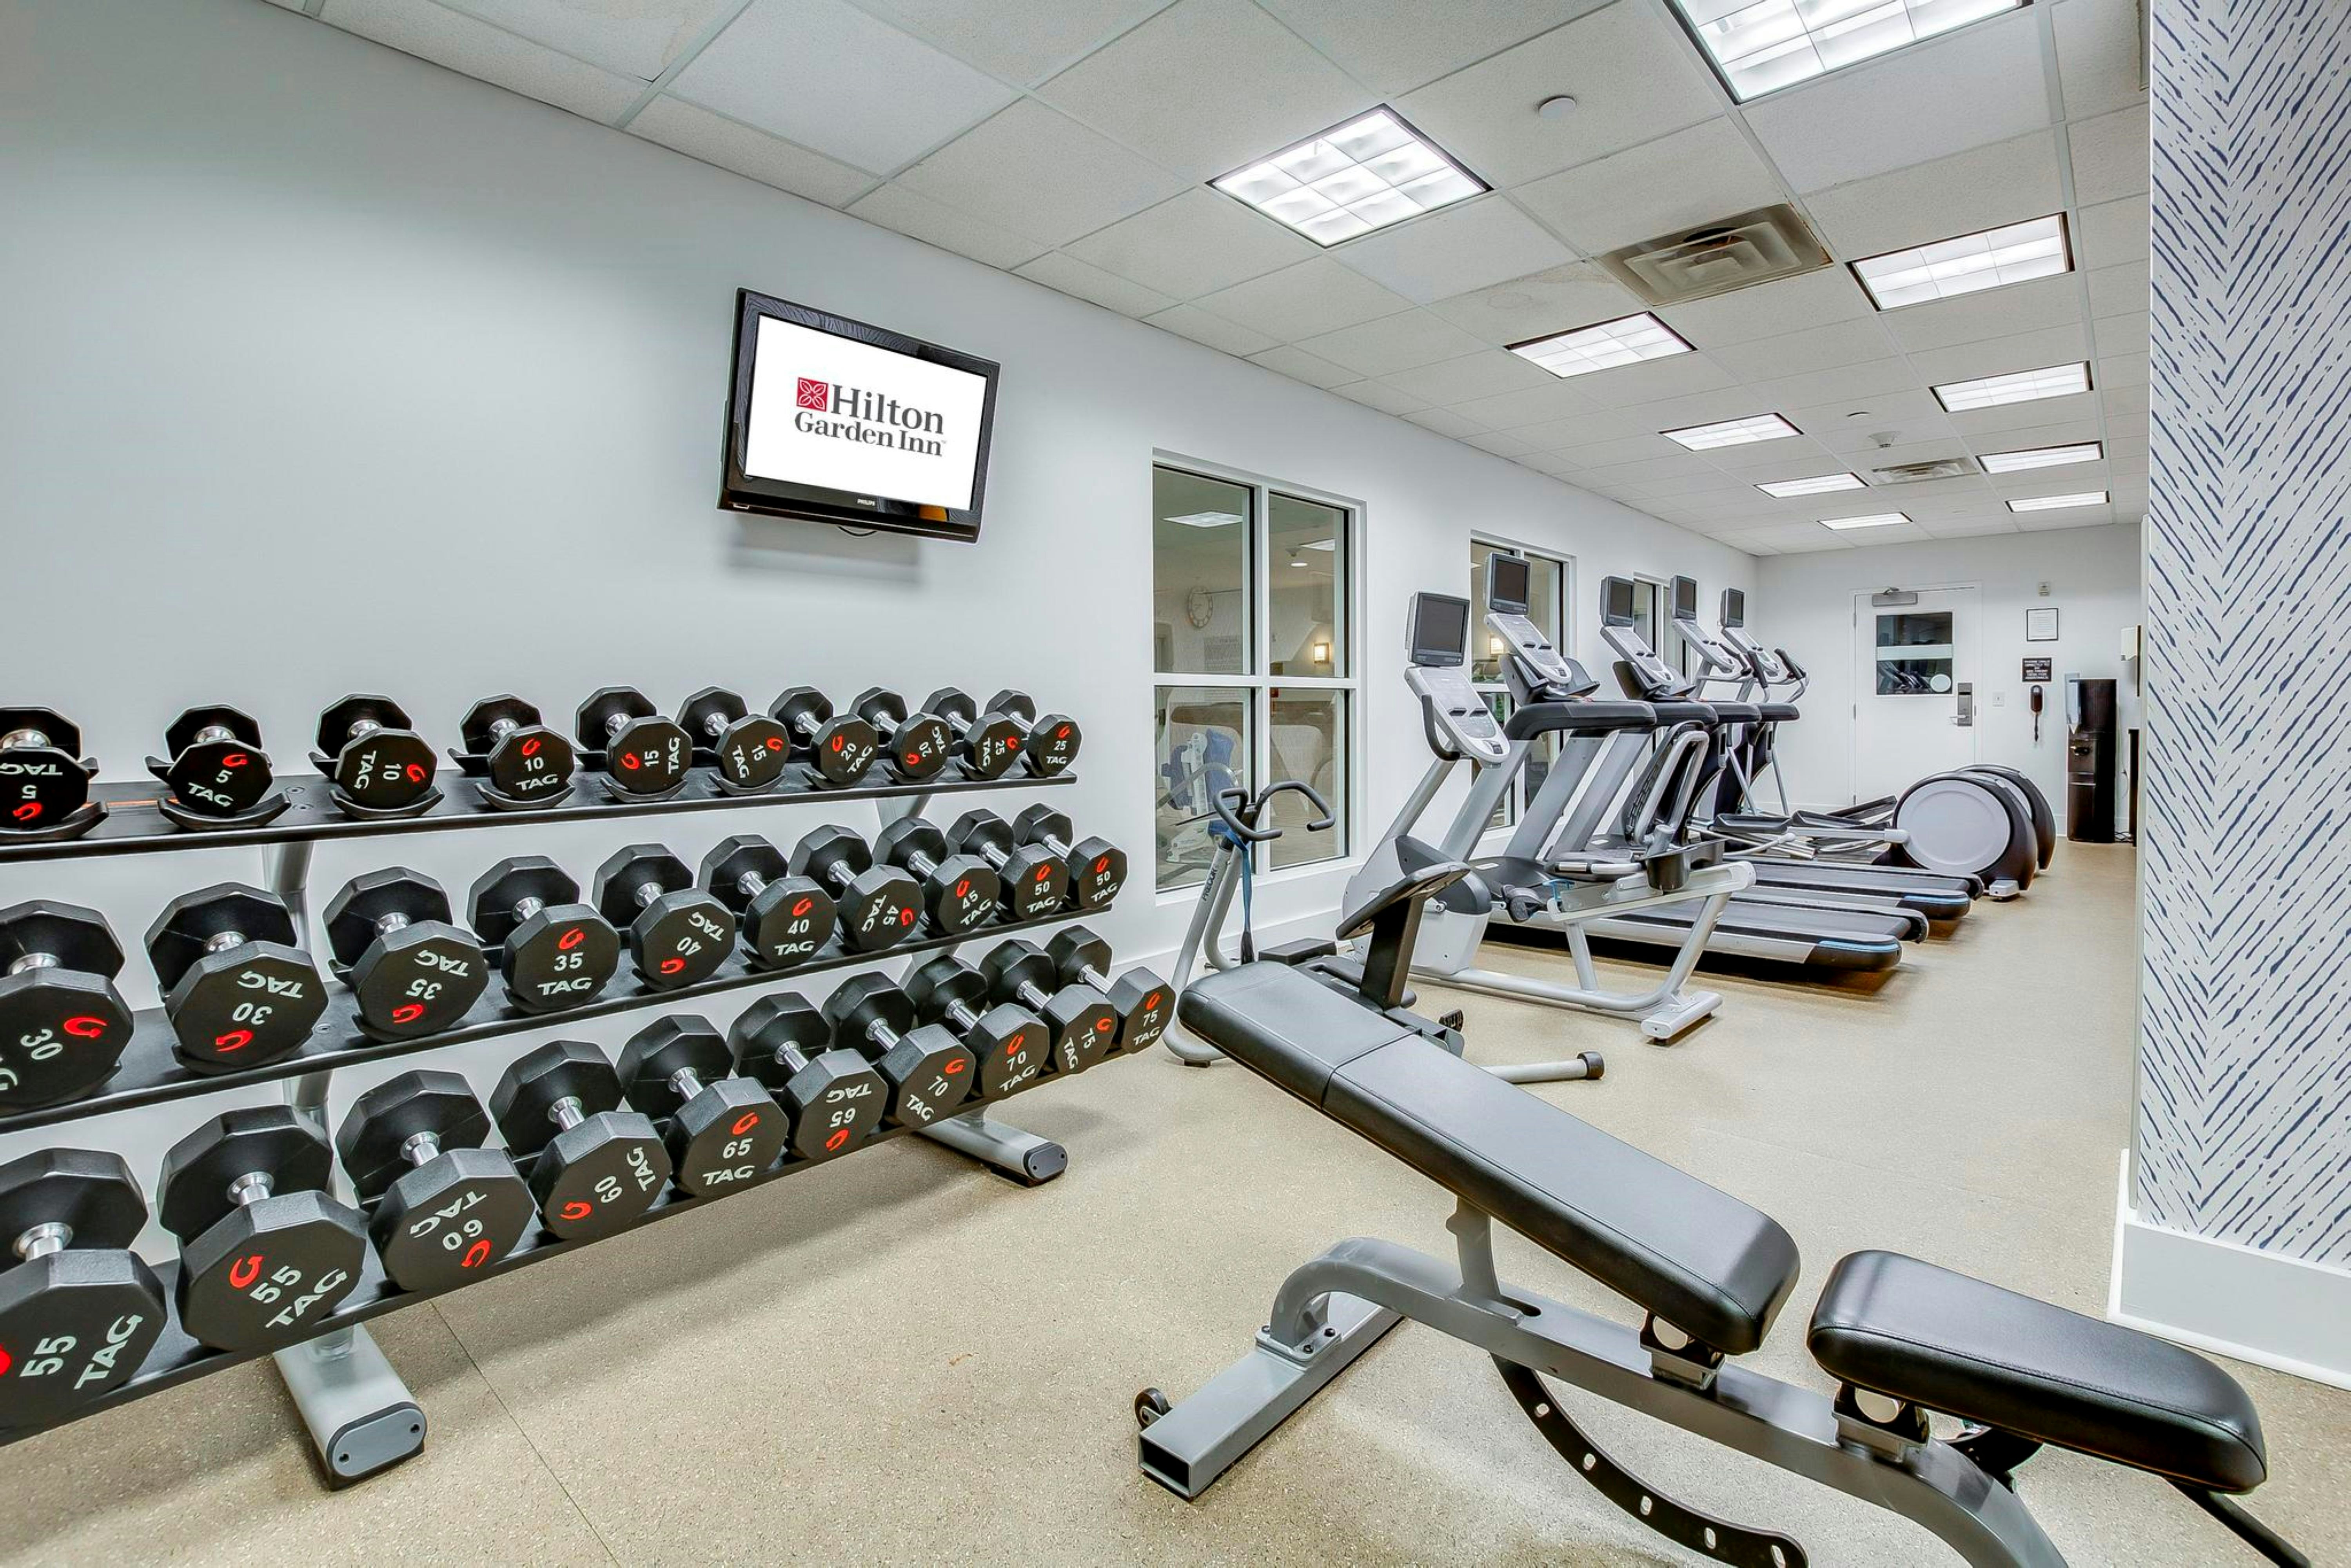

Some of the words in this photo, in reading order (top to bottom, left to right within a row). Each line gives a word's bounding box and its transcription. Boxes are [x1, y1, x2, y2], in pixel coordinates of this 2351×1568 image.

[831, 384, 944, 434] Hilton
[795, 412, 894, 448] Garden
[899, 430, 942, 456] Inn
[919, 742, 932, 757] 20
[932, 726, 946, 754] TAG
[995, 740, 1005, 755] 25
[1054, 740, 1067, 751] 25
[644, 750, 659, 767] 15
[668, 737, 681, 775] TAG
[732, 744, 750, 779] TAG
[752, 744, 767, 761] 15
[841, 743, 857, 761] 20
[847, 745, 873, 774] TAG
[982, 737, 991, 767] TAG
[1046, 756, 1067, 764] TAG
[354, 750, 377, 789] TAG
[383, 764, 402, 780] 10
[525, 757, 544, 771] 10
[216, 769, 232, 783] 5
[516, 774, 558, 791] TAG
[22, 784, 36, 799] 5
[189, 782, 233, 807] TAG
[1035, 881, 1050, 896] 50
[1097, 871, 1110, 886] 50
[962, 890, 978, 909] 45
[1091, 883, 1117, 902] TAG
[861, 895, 887, 932] TAG
[883, 905, 899, 926] 45
[960, 897, 991, 925] TAG
[1026, 897, 1055, 913] TAG
[688, 912, 724, 941] TAG
[788, 919, 810, 935] 40
[677, 937, 702, 956] 40
[774, 940, 815, 955] TAG
[414, 949, 468, 977] TAG
[554, 952, 583, 971] 35
[237, 971, 303, 998] TAG
[405, 978, 442, 1000] 35
[537, 977, 592, 995] TAG
[232, 1002, 272, 1025] 30
[1144, 1009, 1158, 1027] 75
[20, 1029, 63, 1060] 30
[1081, 1027, 1095, 1049] 75
[1133, 1027, 1160, 1045] TAG
[1007, 1051, 1026, 1071] 70
[1064, 1037, 1078, 1069] TAG
[928, 1075, 948, 1096] 70
[999, 1064, 1035, 1091] TAG
[826, 1083, 872, 1103] TAG
[830, 1108, 856, 1127] 65
[906, 1094, 934, 1122] TAG
[723, 1138, 753, 1158] 65
[626, 1147, 656, 1192] TAG
[703, 1165, 755, 1185] TAG
[594, 1176, 623, 1203] 60
[409, 1191, 487, 1238] TAG
[442, 1219, 483, 1250] 60
[249, 1265, 301, 1304] 55
[265, 1269, 348, 1328] TAG
[20, 1336, 77, 1377] 55
[74, 1314, 143, 1390] TAG
